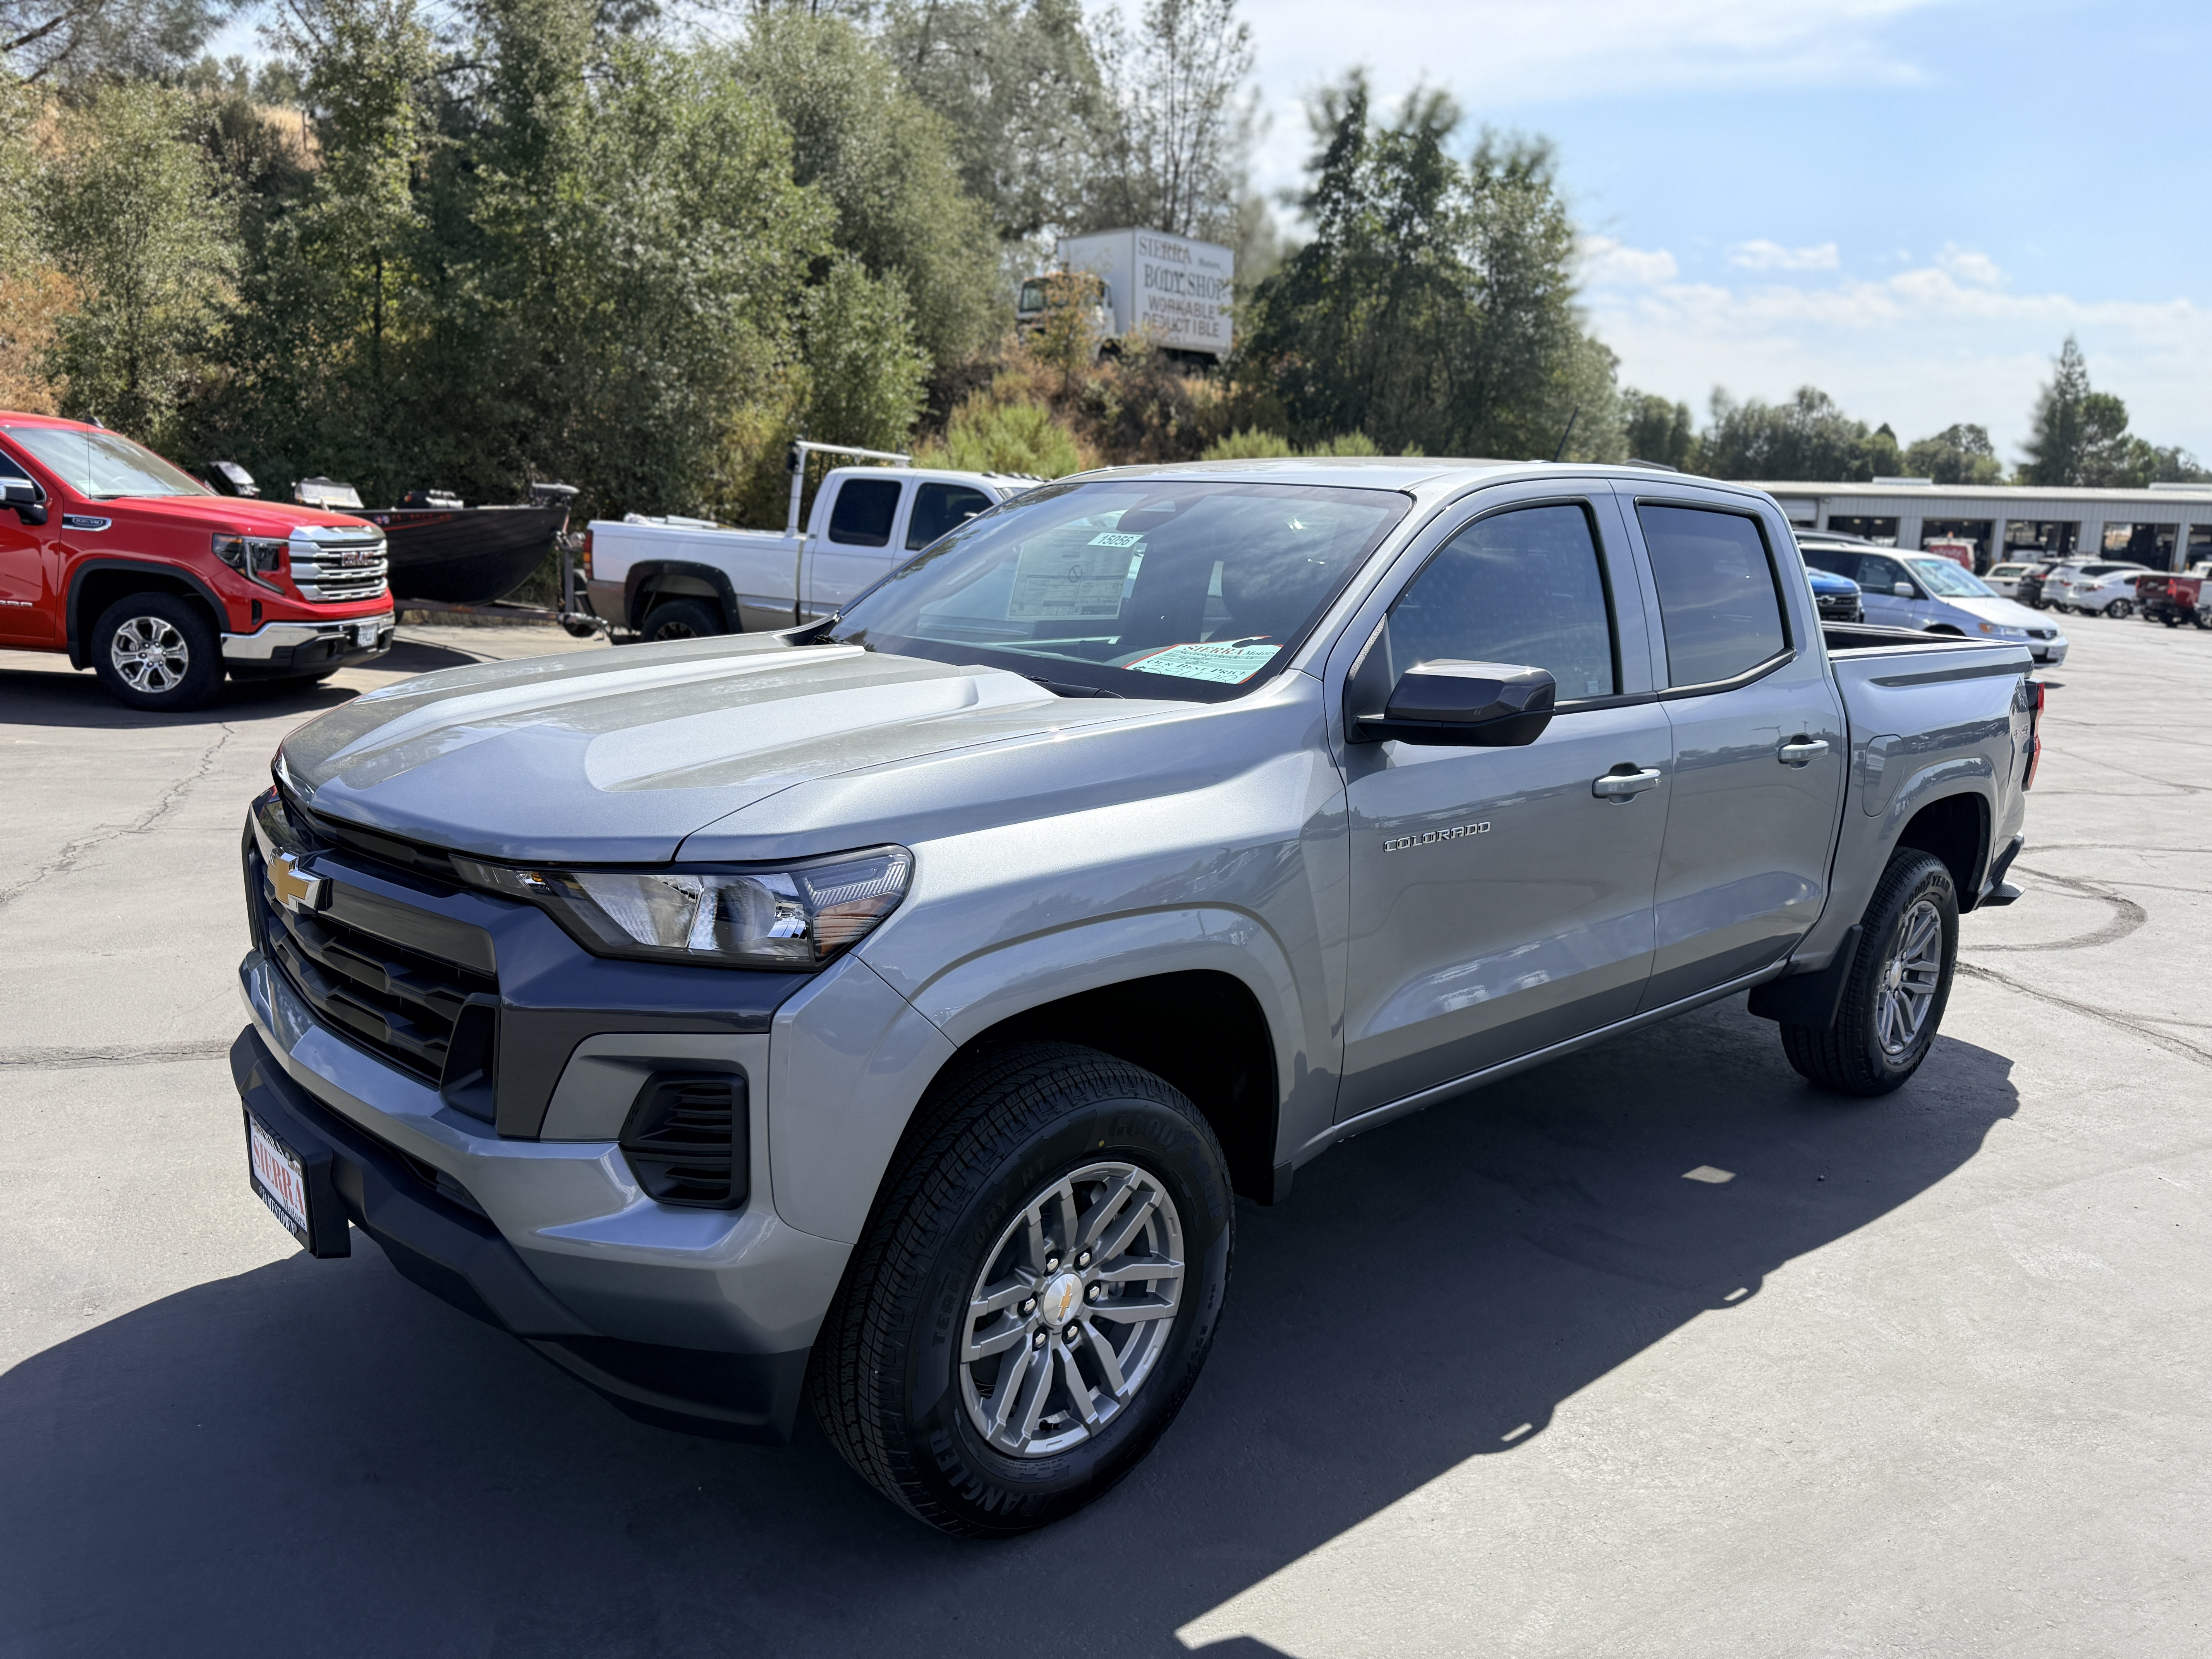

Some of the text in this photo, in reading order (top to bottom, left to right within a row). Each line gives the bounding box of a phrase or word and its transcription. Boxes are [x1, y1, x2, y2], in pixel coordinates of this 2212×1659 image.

[1138, 236, 1192, 264] SIERRA
[1144, 264, 1224, 301] BODY SHOP
[1148, 295, 1215, 319] WORKABLE
[1098, 534, 1134, 546] 15056
[342, 551, 374, 566] GMC
[1183, 645, 1244, 655] SIERRA
[1384, 821, 1491, 853] COLORADO
[1902, 871, 1951, 914] GOODYEAR
[252, 1135, 306, 1217] SIERRA
[1108, 1112, 1223, 1222] GOODYEAR
[262, 1188, 295, 1236] JAMESTOWN
[283, 1195, 306, 1229] Motors
